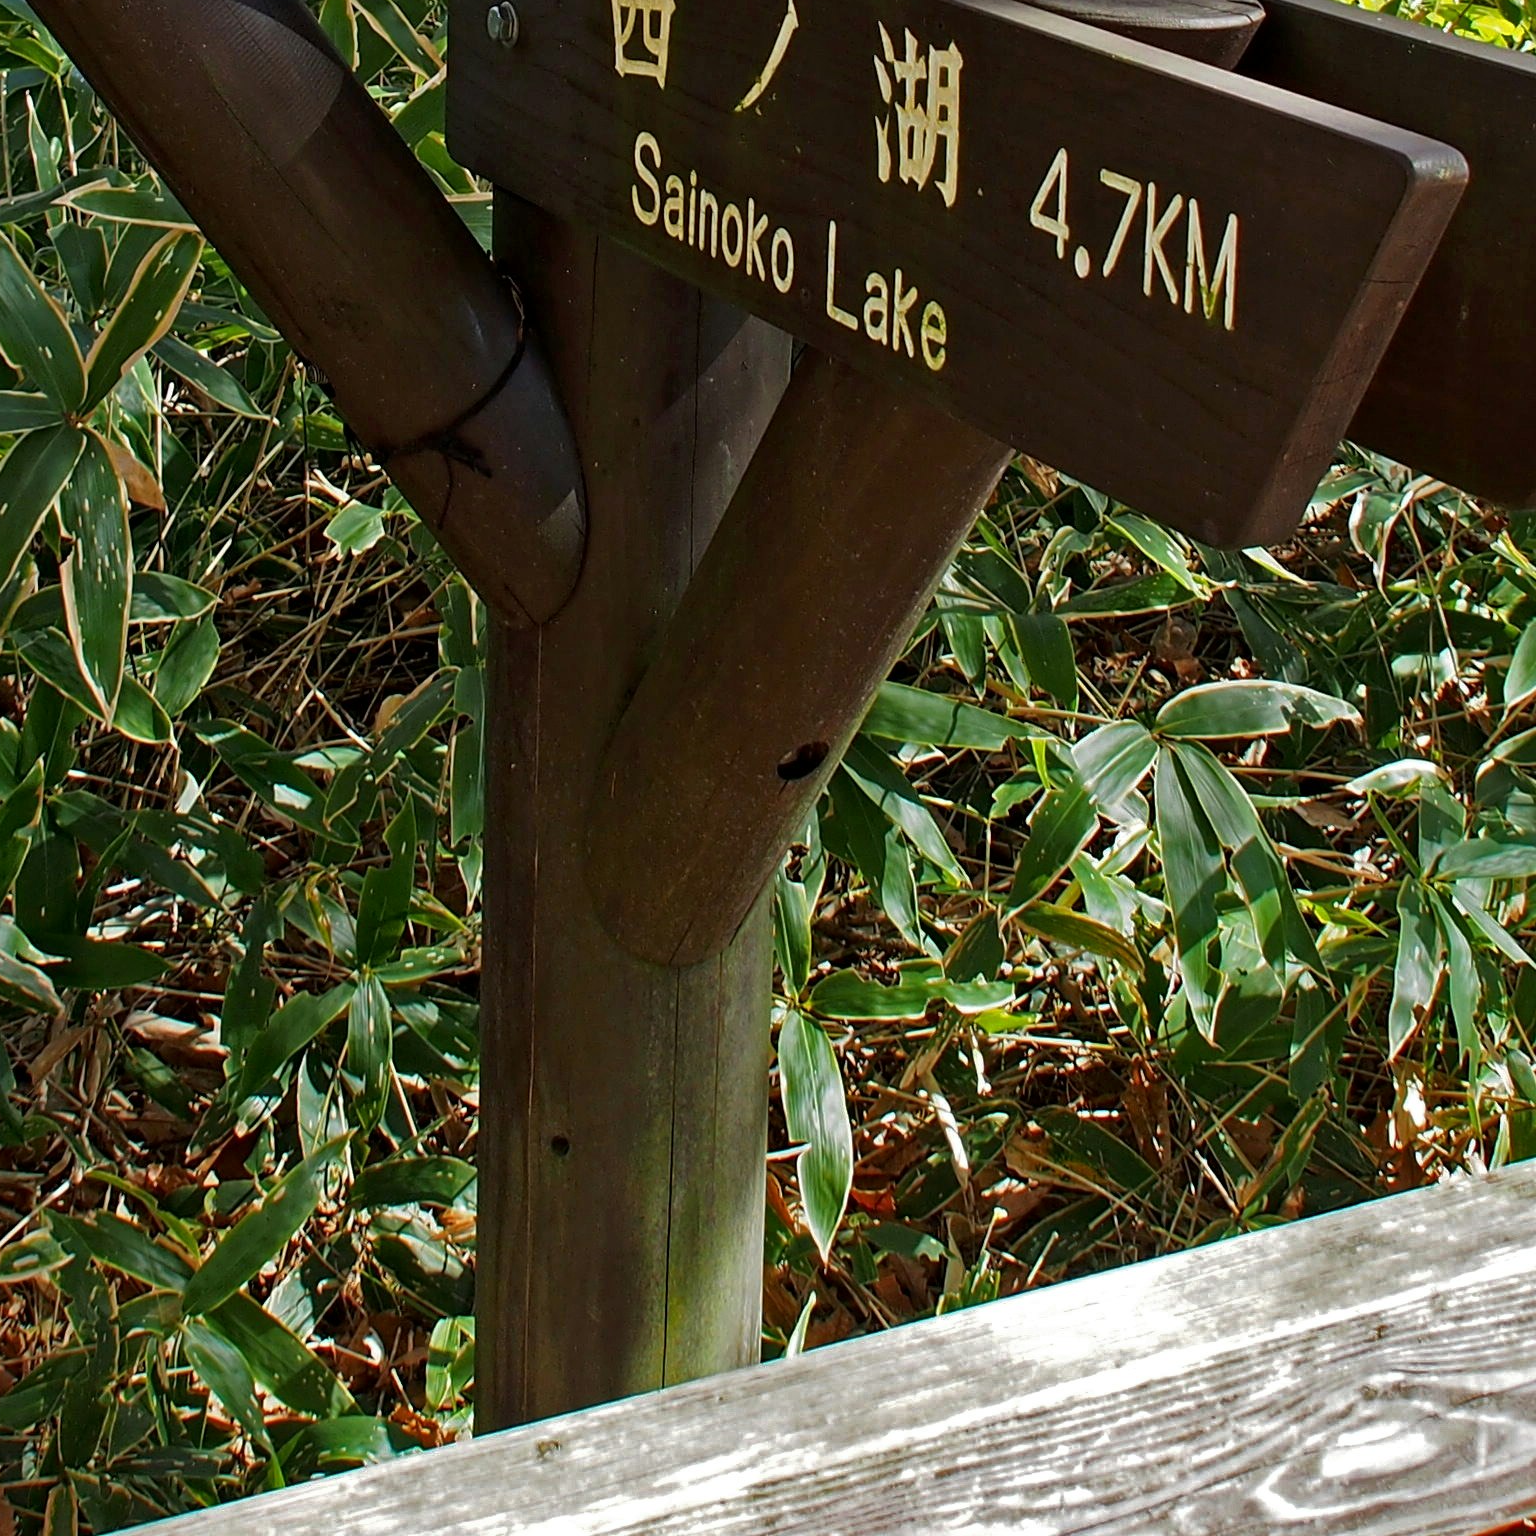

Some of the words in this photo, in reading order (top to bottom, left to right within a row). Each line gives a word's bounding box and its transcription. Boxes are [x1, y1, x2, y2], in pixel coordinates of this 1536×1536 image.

[631, 131, 794, 293] Sainoko
[826, 220, 947, 371] Lake
[1029, 147, 1238, 331] 4.7KM
